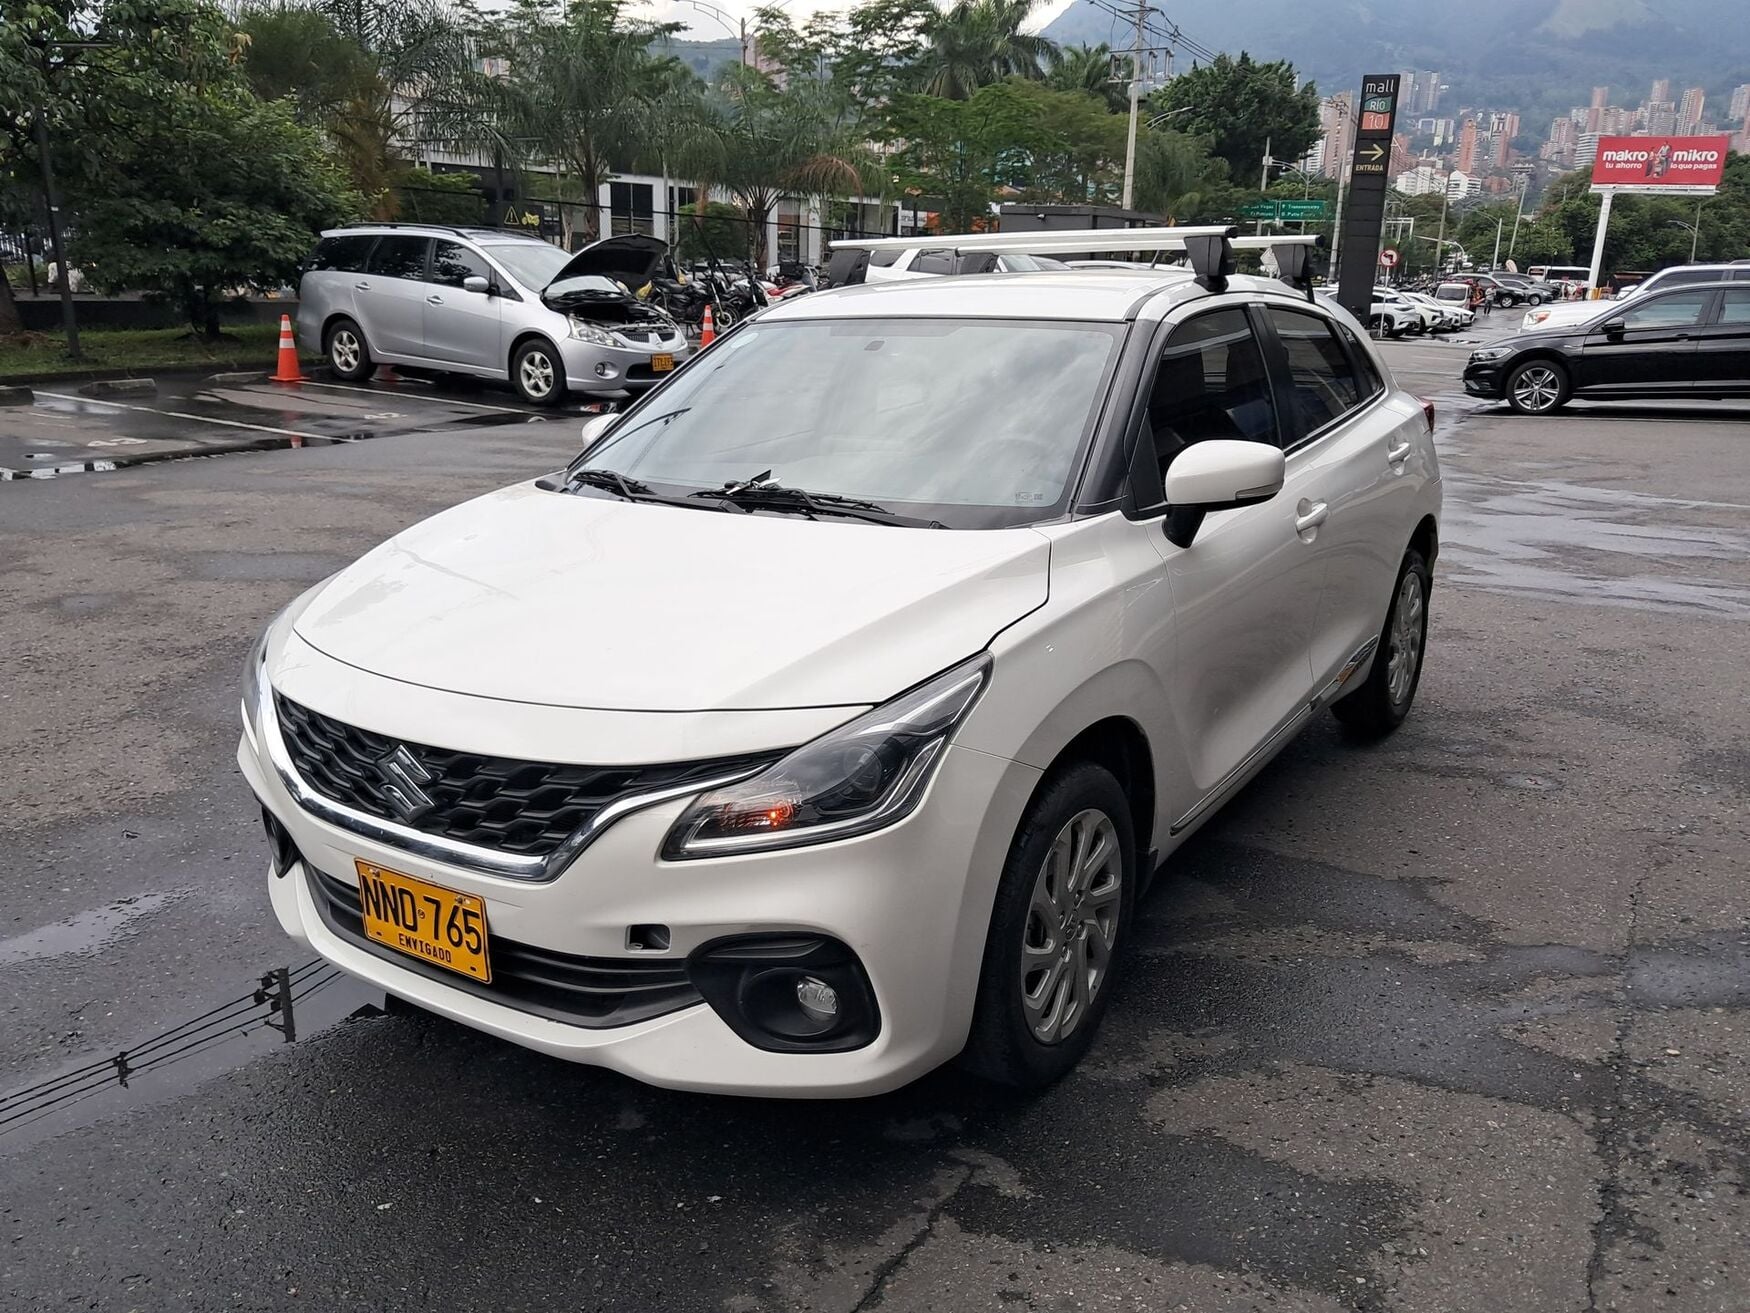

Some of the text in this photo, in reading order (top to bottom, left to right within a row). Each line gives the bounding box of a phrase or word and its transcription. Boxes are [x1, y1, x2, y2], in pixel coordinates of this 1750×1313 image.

[1366, 80, 1394, 93] mall
[1369, 114, 1384, 129] 10
[1602, 149, 1719, 161] makro mikro
[1355, 164, 1384, 172] ENTRADA
[361, 874, 482, 955] NND 765
